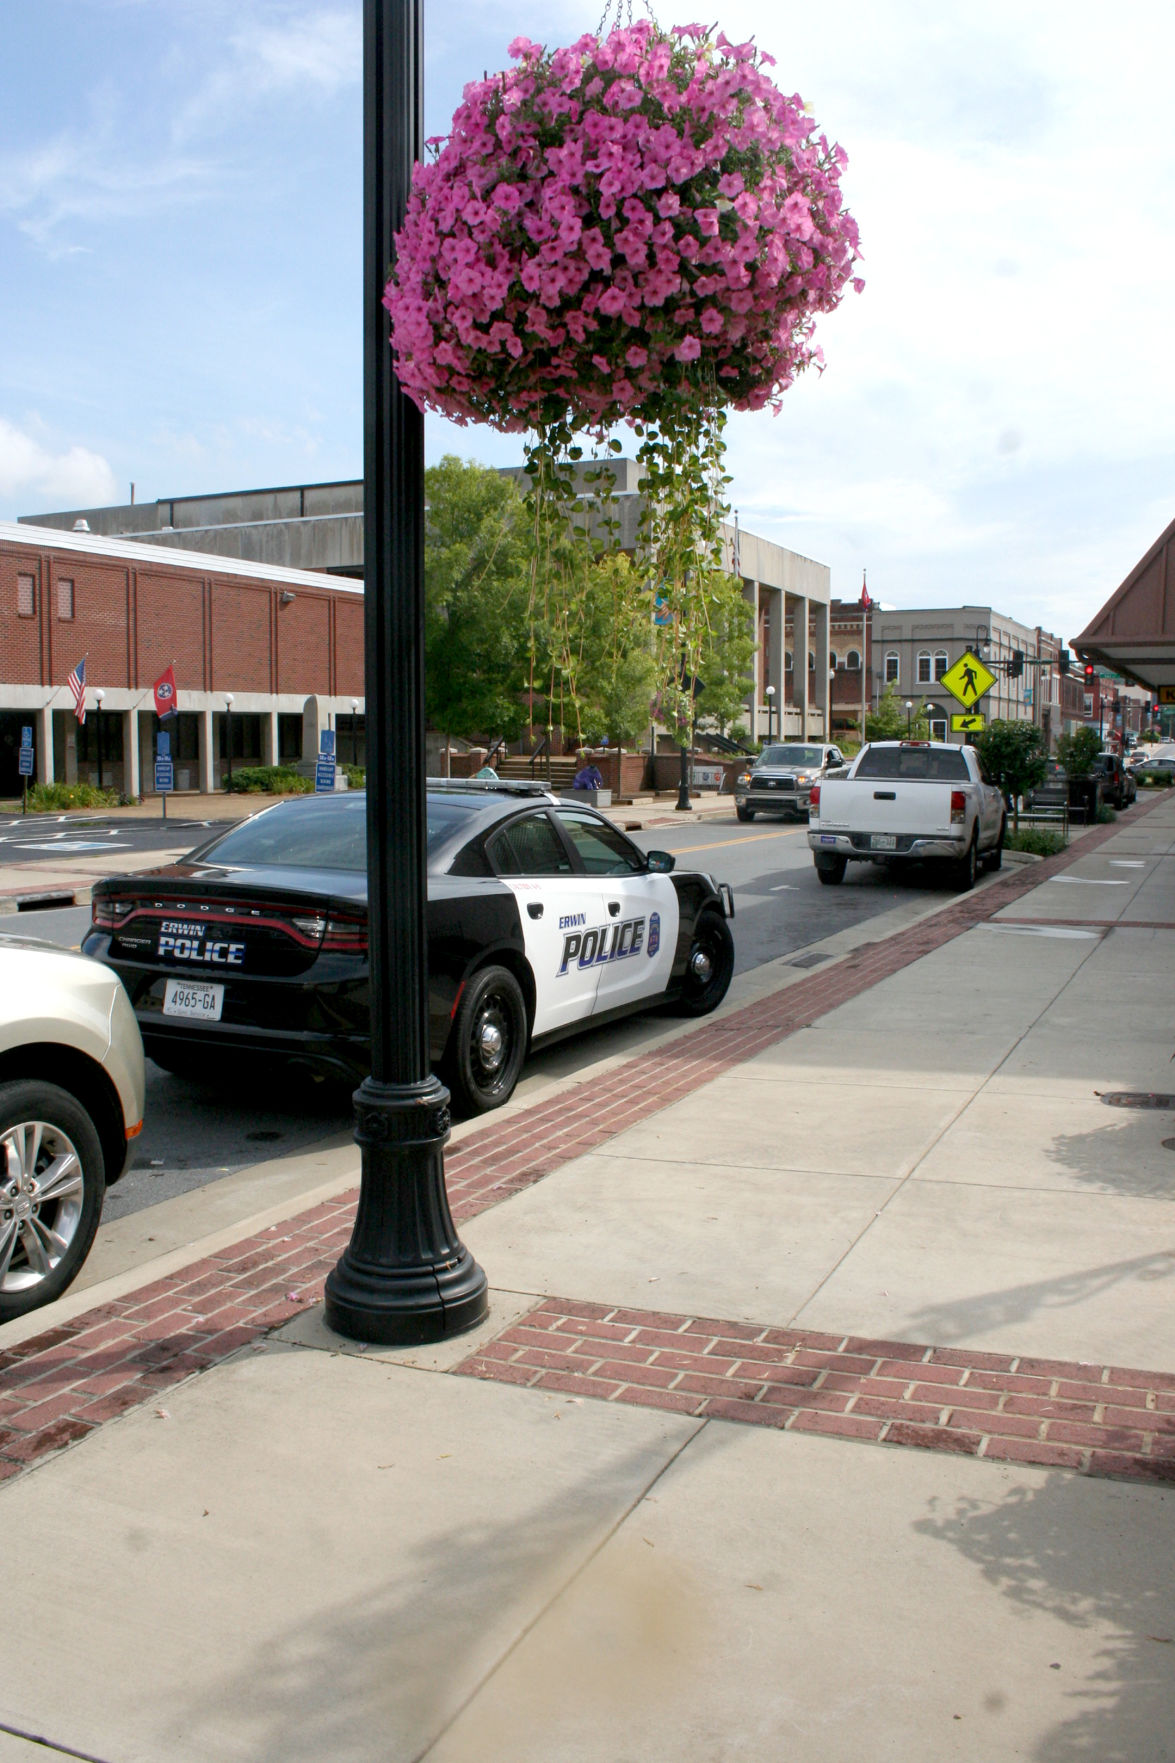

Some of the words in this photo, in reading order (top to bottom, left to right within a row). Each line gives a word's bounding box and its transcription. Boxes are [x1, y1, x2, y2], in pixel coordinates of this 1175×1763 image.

[154, 902, 260, 916] DODGE
[161, 921, 206, 937] ERWIN
[559, 912, 587, 930] ERWIN
[158, 936, 245, 964] POLICE
[556, 916, 646, 977] POLICE
[179, 982, 210, 992] TENNESSEE
[171, 990, 216, 1011] 4965-GA
